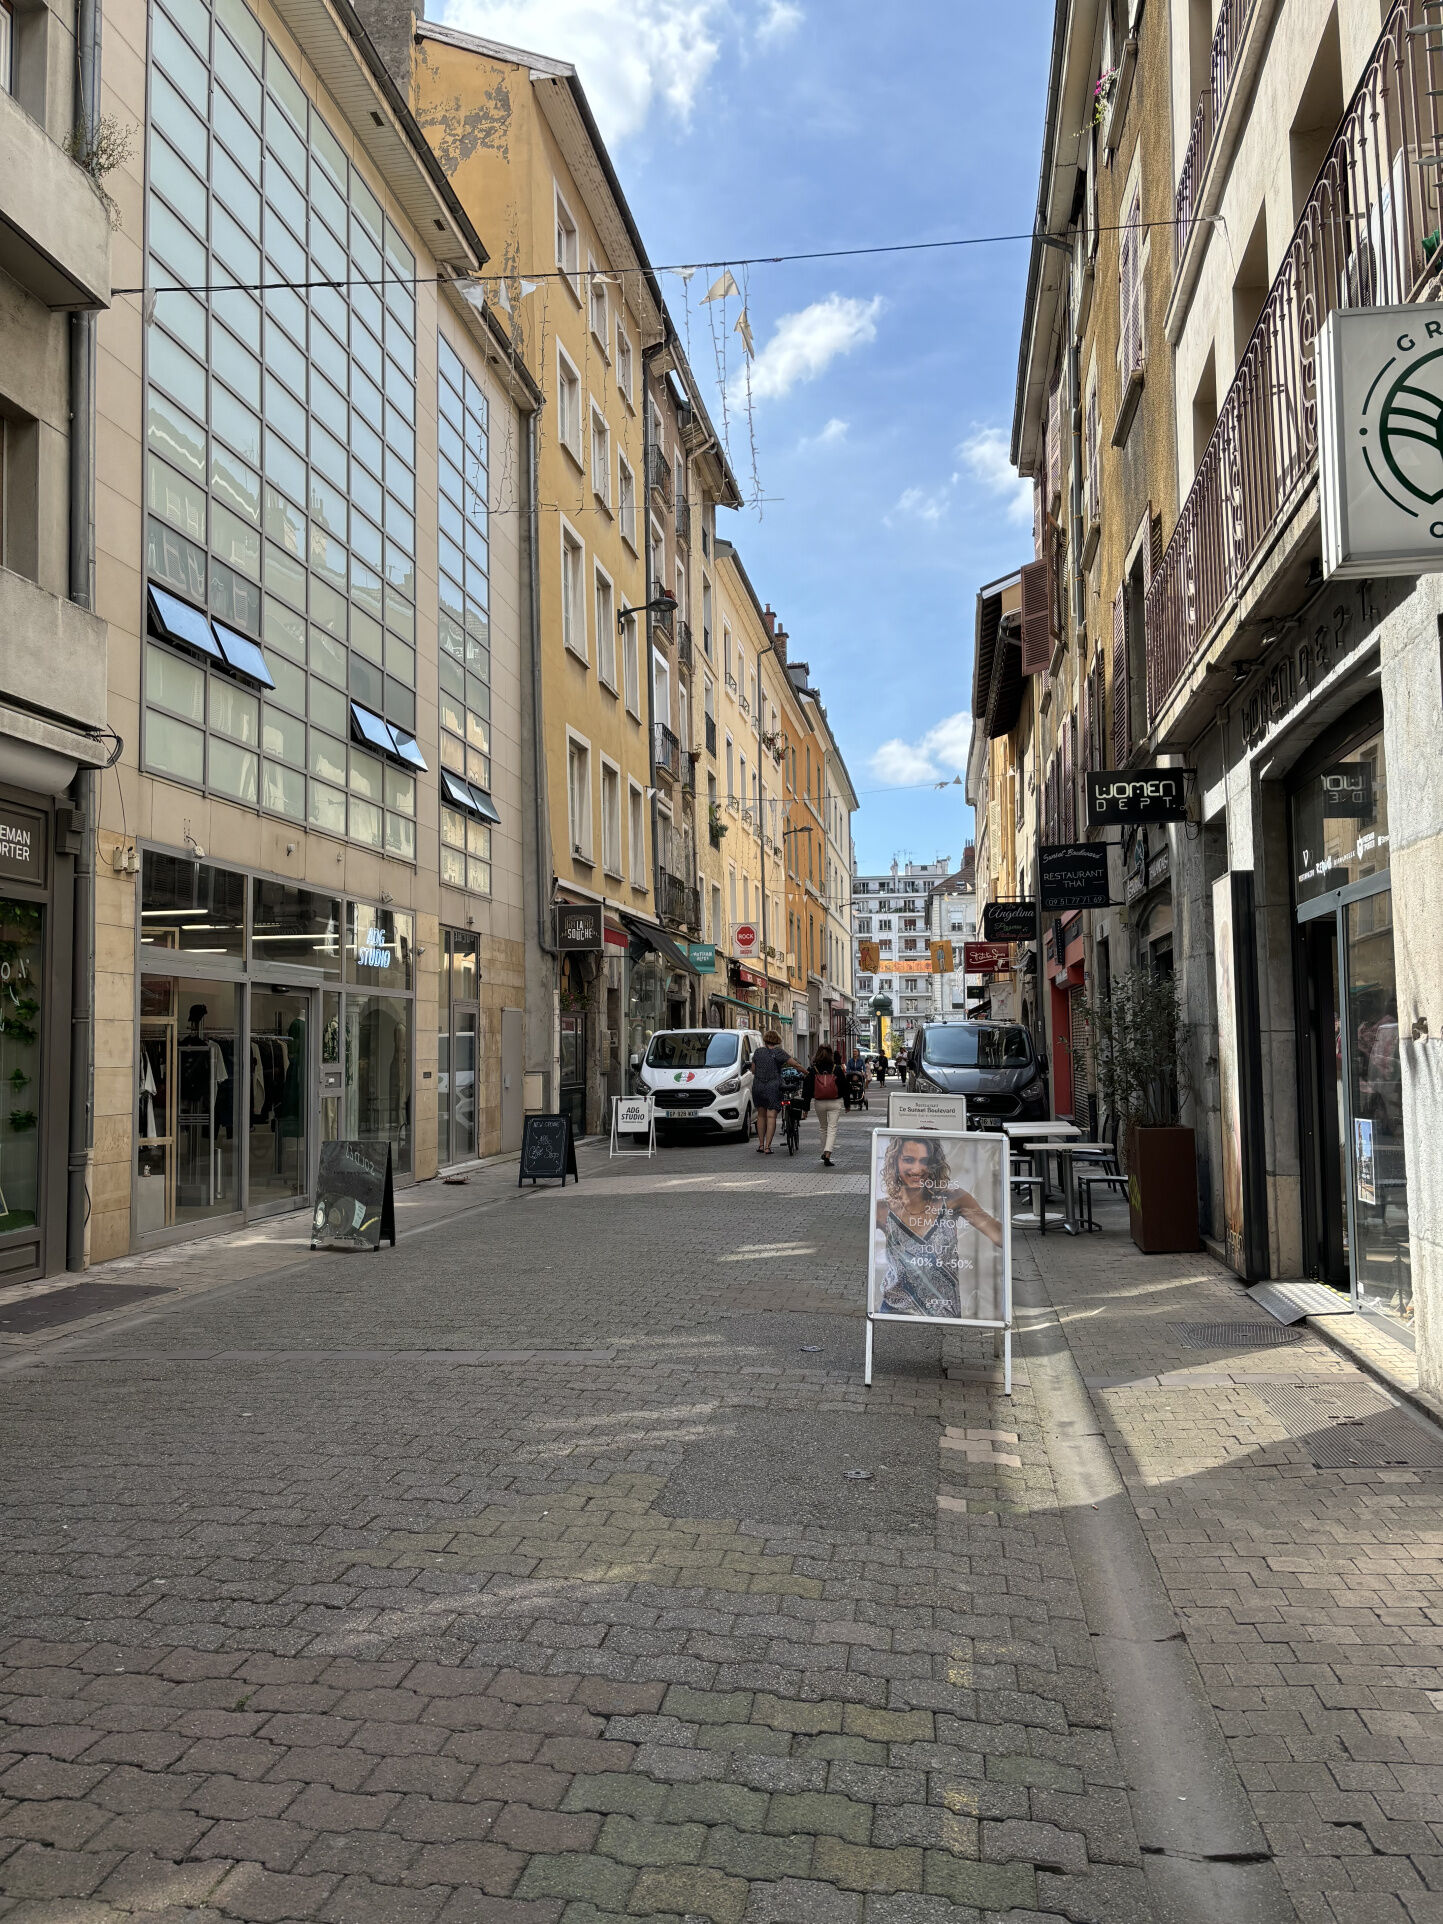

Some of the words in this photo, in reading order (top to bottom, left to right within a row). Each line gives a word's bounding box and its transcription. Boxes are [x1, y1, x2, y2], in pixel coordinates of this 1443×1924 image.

[1095, 780, 1176, 799] WOMEN
[1096, 796, 1176, 812] DEPT.
[0, 841, 30, 862] RTER
[1043, 869, 1104, 881] RESTAURANT
[988, 904, 1034, 922] Angelina
[576, 920, 584, 931] LA
[567, 928, 593, 941] SOUCHE
[738, 932, 754, 940] ROCK
[357, 946, 391, 968] STUDIO
[626, 1106, 640, 1114] ADG
[621, 1113, 645, 1121] STUDIO
[919, 1178, 960, 1190] SOLDES
[919, 1244, 950, 1255] TOUT
